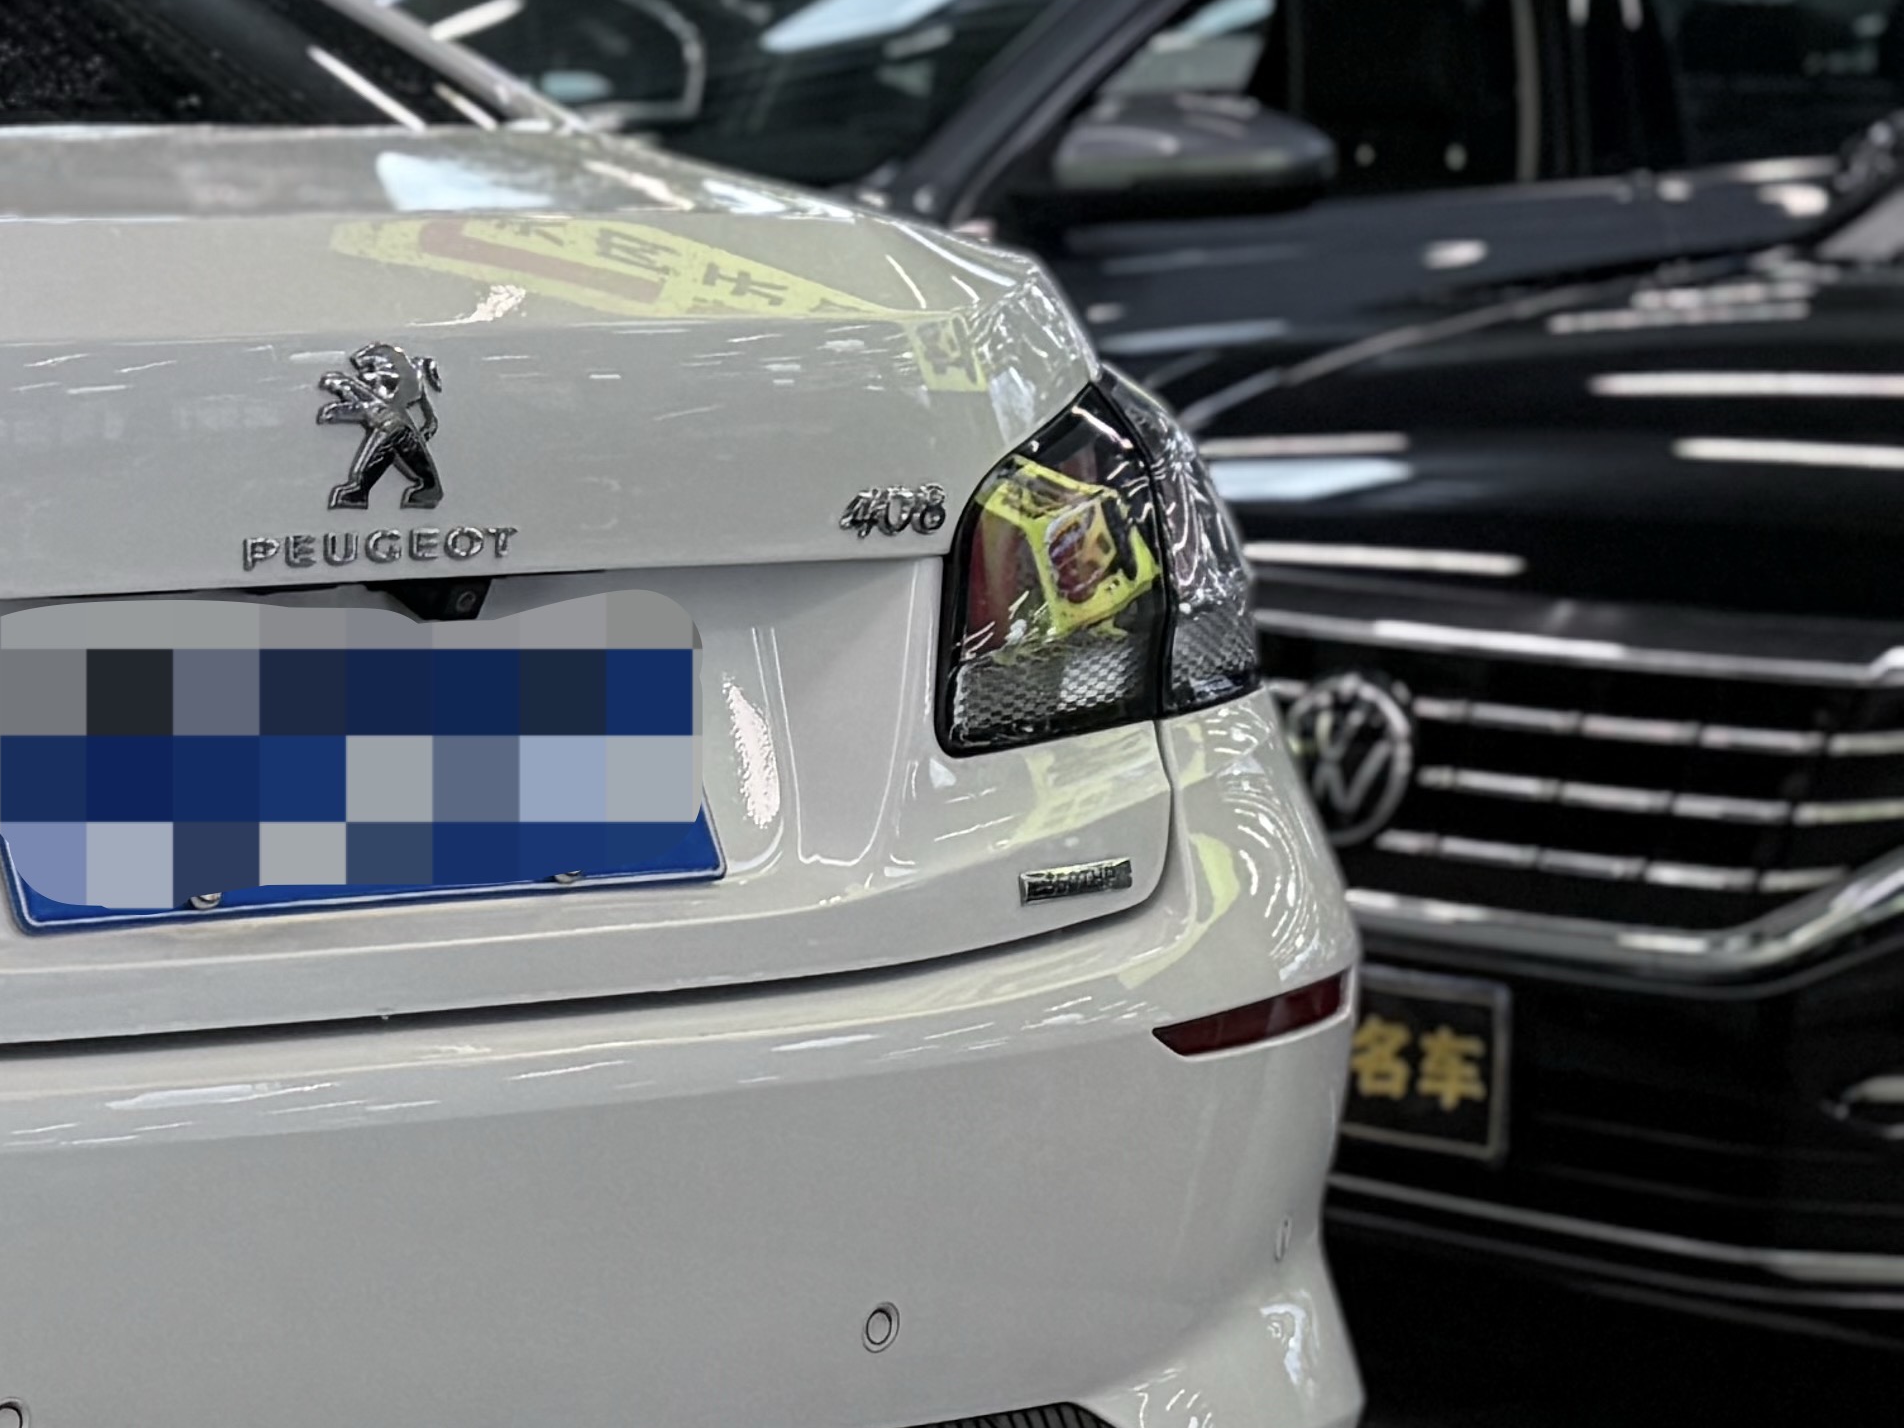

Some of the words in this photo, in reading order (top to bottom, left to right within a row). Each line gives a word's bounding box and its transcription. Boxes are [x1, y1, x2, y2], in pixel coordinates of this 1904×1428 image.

[838, 482, 948, 540] 408
[242, 525, 520, 572] PEUGEOT
[1349, 1012, 1487, 1112] 名车
